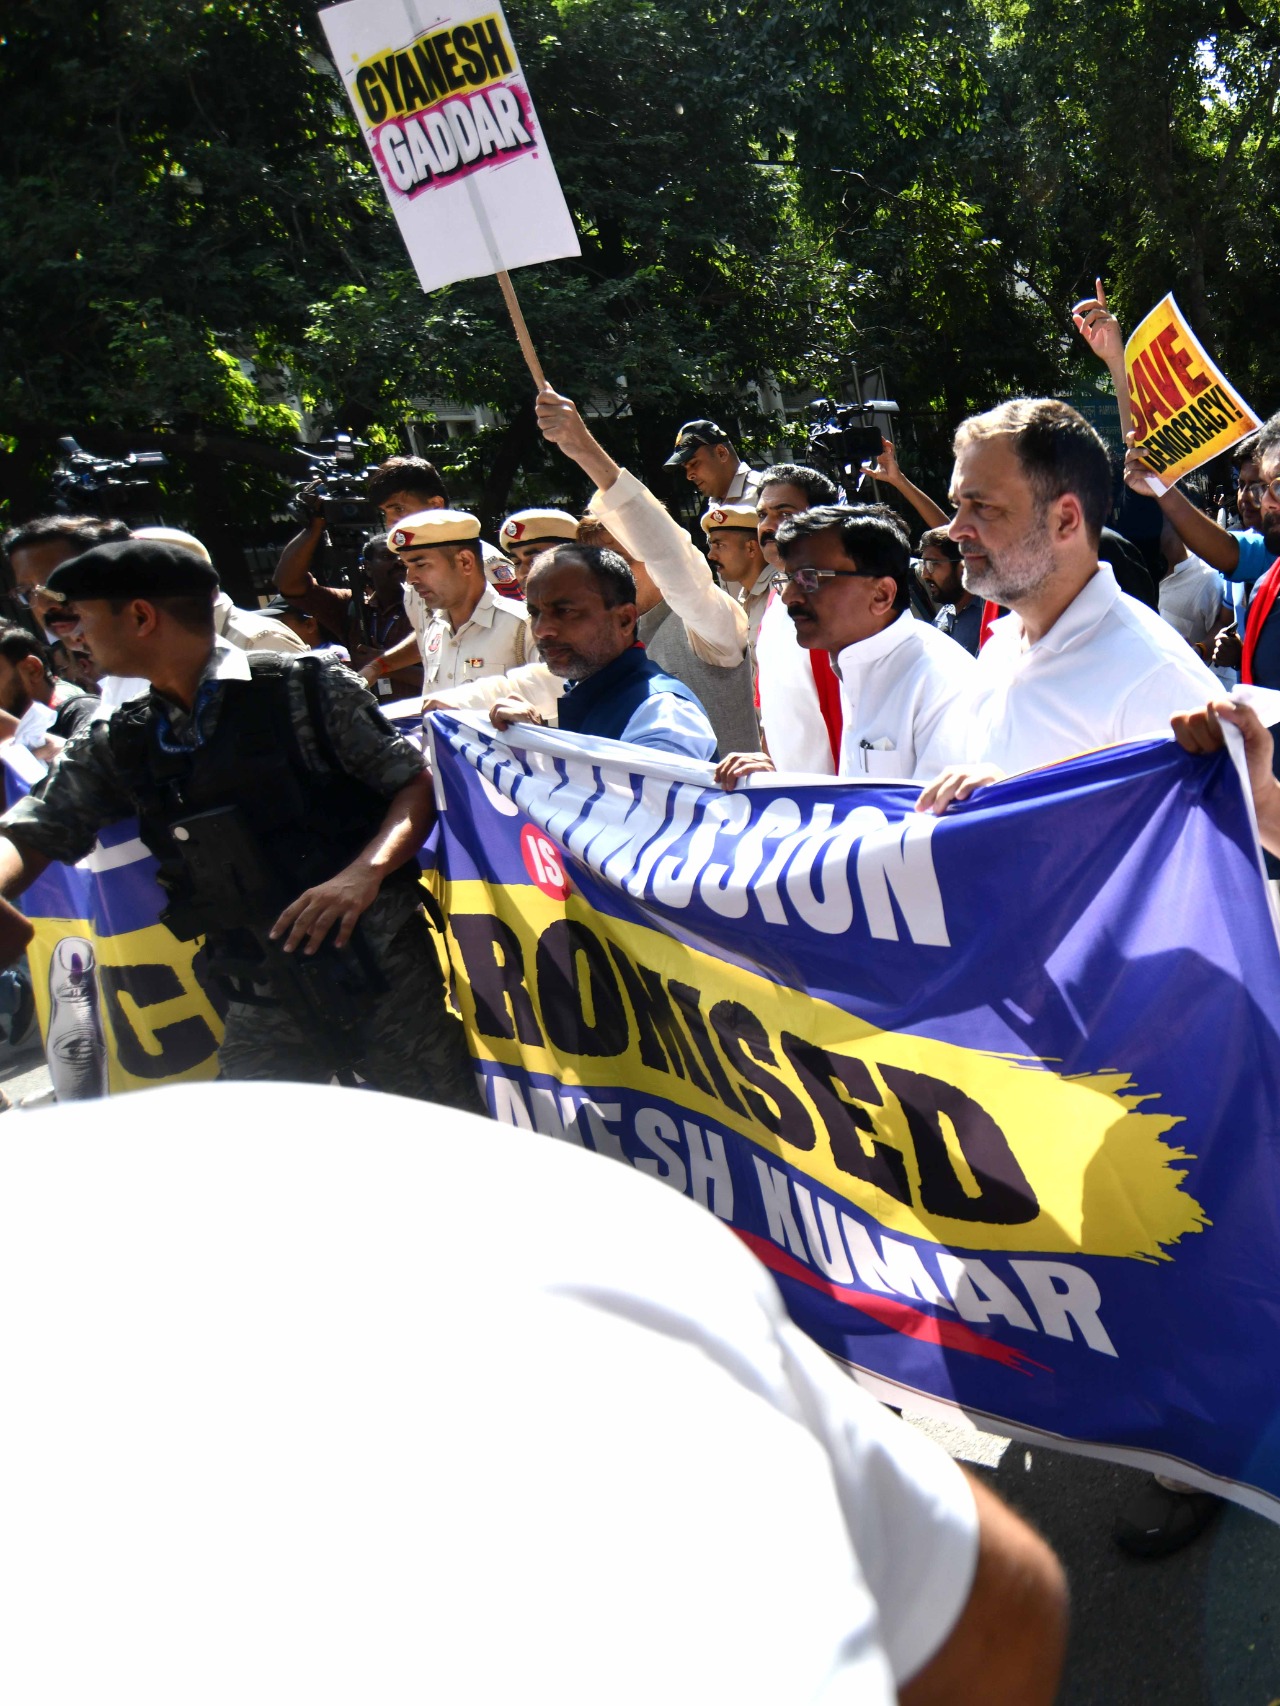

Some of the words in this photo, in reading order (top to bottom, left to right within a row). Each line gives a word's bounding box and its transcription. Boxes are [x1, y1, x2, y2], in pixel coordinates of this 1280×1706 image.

[356, 19, 513, 125] GYANESH
[379, 87, 535, 193] GADDAR
[1126, 322, 1212, 442] SAVE
[1136, 383, 1244, 474] DEMOCRACY!
[526, 835, 565, 887] IS
[753, 1154, 1119, 1358] KUMAR
